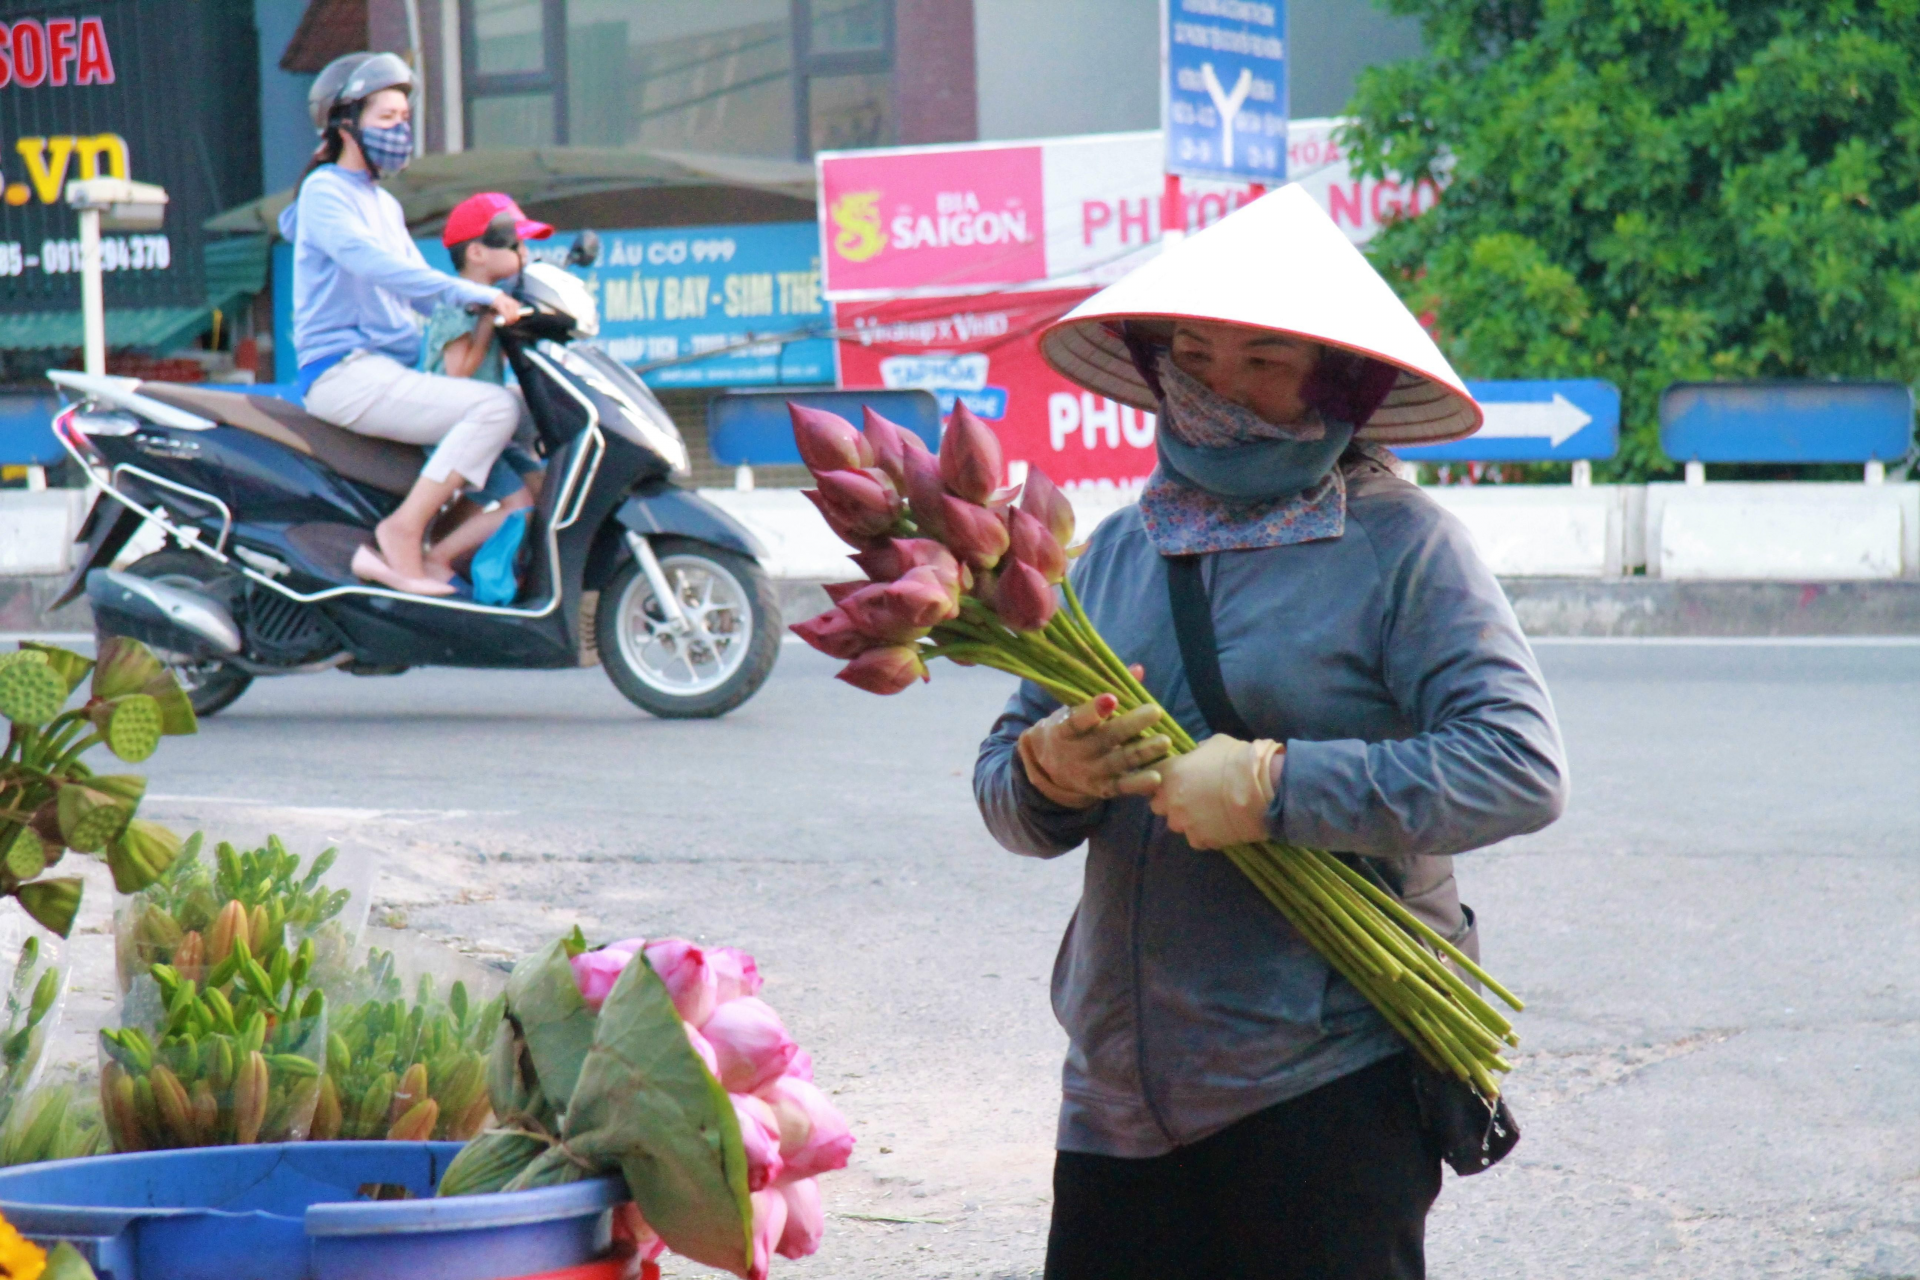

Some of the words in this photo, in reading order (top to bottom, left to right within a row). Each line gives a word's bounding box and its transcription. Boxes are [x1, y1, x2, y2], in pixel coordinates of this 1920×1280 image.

[0, 17, 115, 88] SOFA
[936, 191, 979, 213] BIA
[890, 209, 1028, 249] SAIGON
[605, 270, 660, 322] MÁY
[662, 275, 710, 320] BAY
[724, 273, 773, 318] SIM
